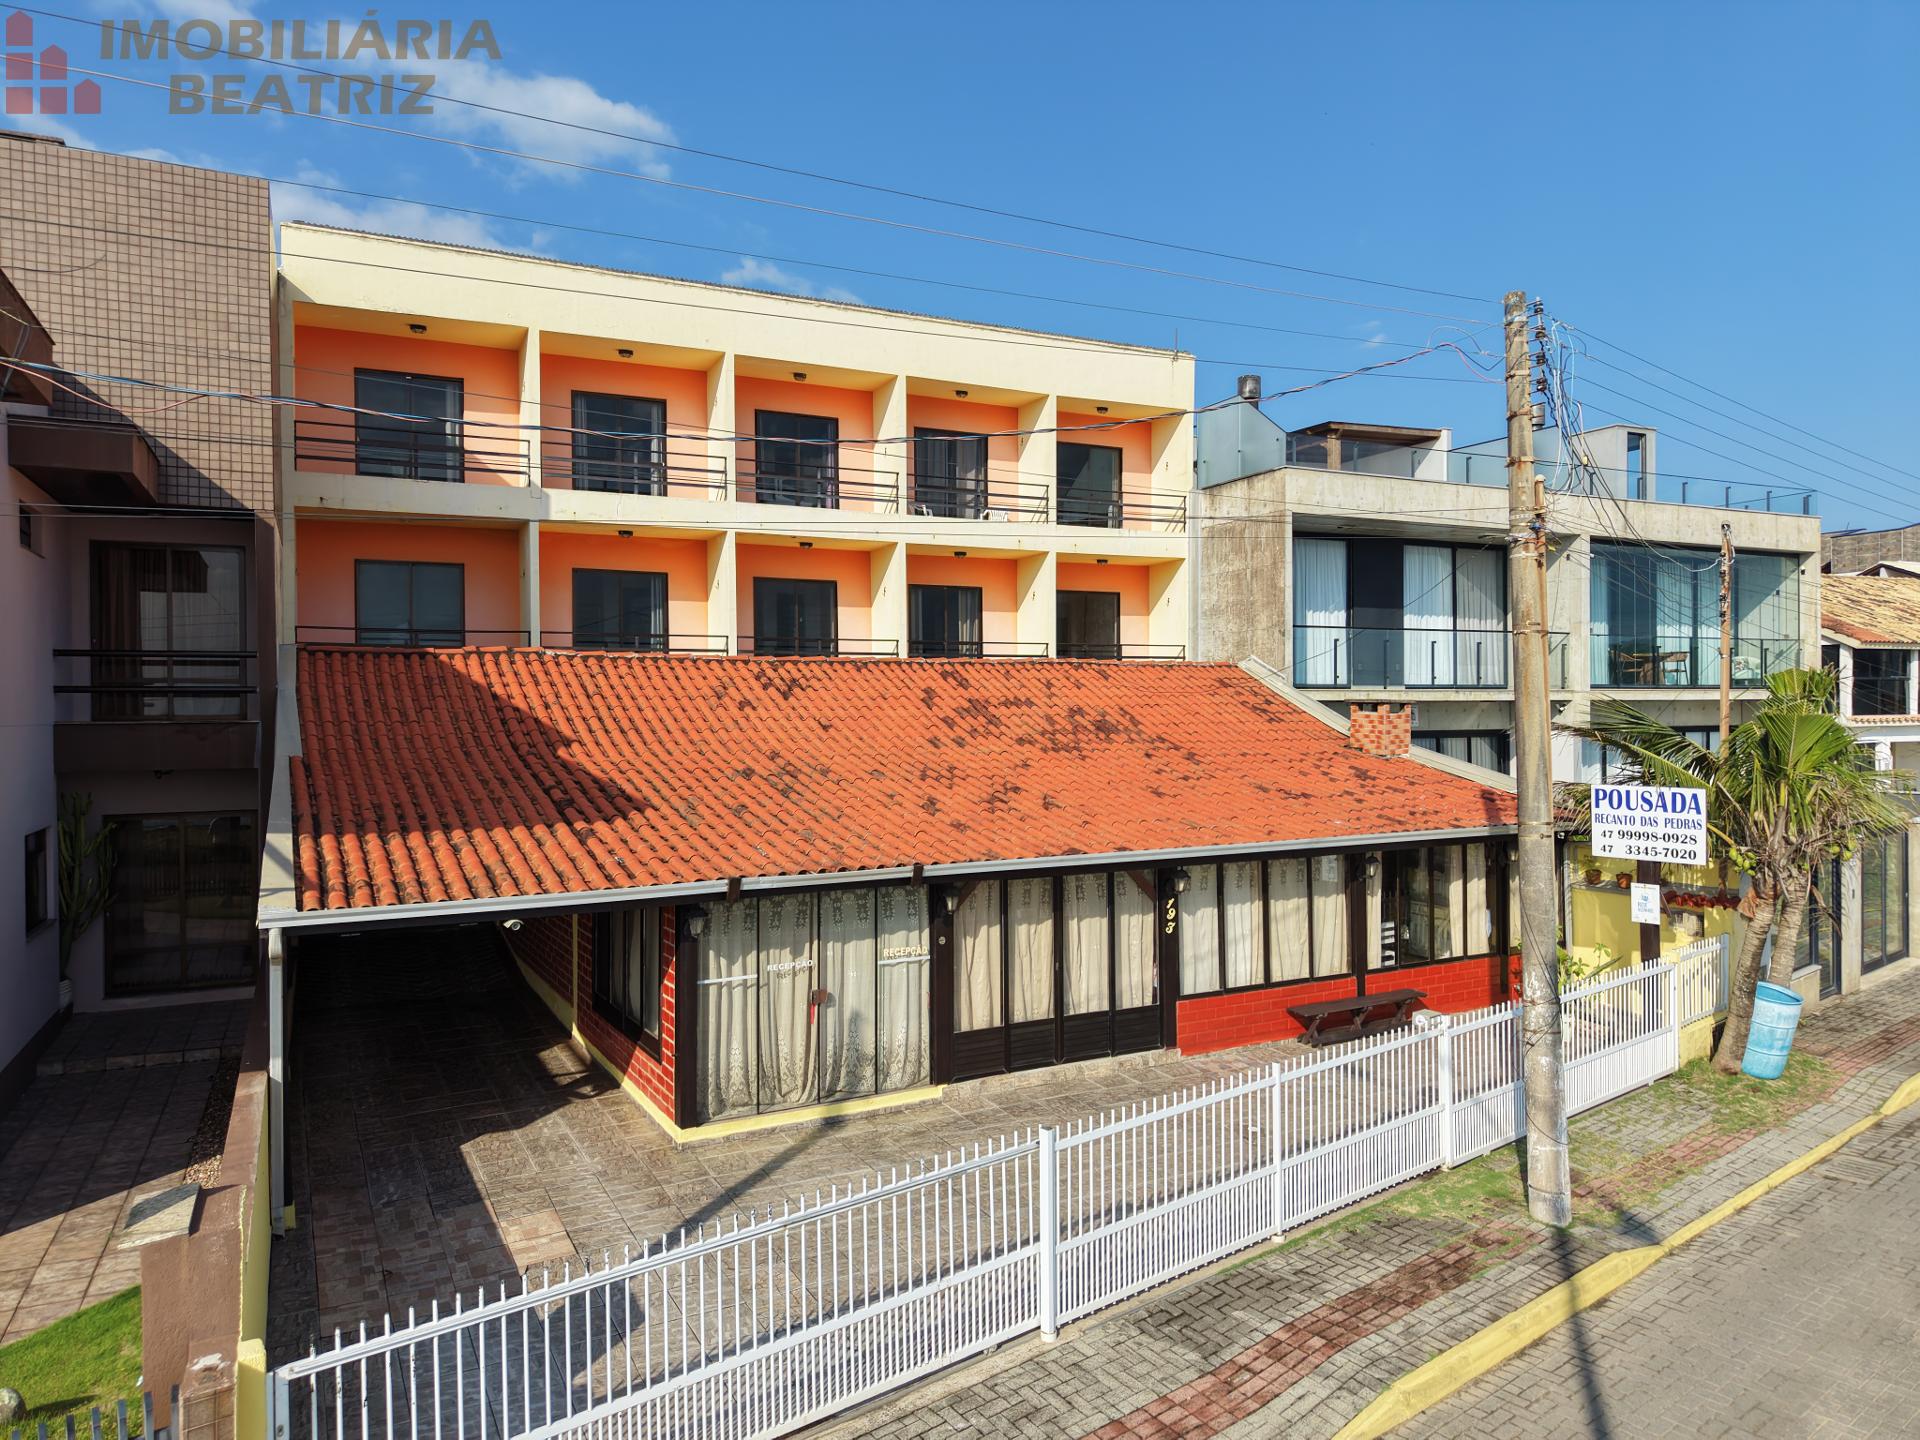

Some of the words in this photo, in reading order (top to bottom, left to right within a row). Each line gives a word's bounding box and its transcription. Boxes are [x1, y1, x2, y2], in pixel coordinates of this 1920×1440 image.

[1594, 788, 1702, 815] POUSADA
[1594, 813, 1636, 826] RECANTO
[1640, 816, 1659, 828] DAS
[1664, 818, 1703, 831] PEDRAS
[1600, 830, 1613, 839] 47
[1617, 830, 1698, 845] 99998-0928
[1600, 845, 1613, 853] 47
[1625, 845, 1697, 861] 3345-7020
